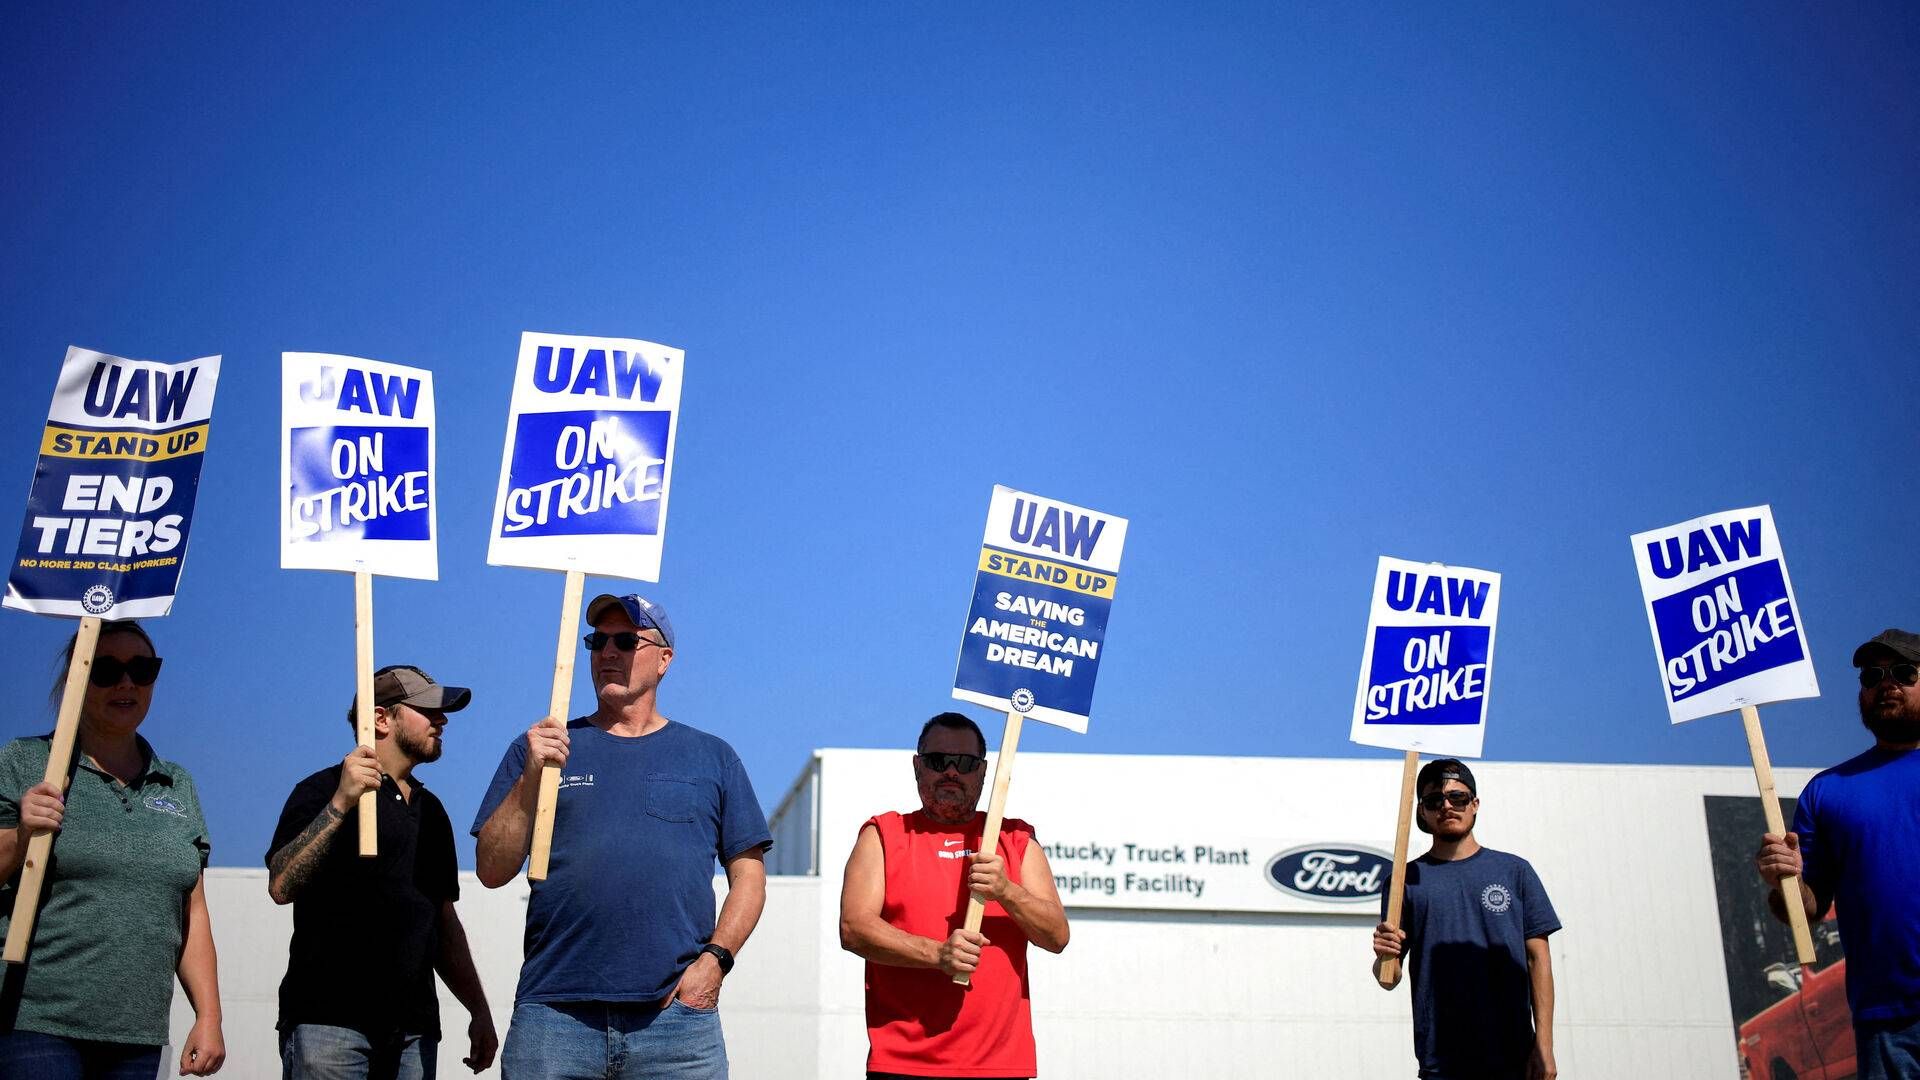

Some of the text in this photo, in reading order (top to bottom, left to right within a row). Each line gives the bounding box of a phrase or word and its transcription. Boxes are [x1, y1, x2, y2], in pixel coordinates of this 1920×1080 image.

[83, 362, 199, 423] UAW
[533, 346, 670, 403] UAW
[52, 431, 200, 458] STAND UP
[330, 432, 383, 479] ON
[555, 416, 619, 470] ON
[62, 474, 174, 513] END
[290, 471, 428, 538] STRIKE
[504, 458, 664, 532] STRIKE
[32, 514, 184, 557] TIERS
[1010, 498, 1106, 561] UAW
[1647, 518, 1761, 580] UAW
[19, 557, 177, 573] NO MORE 2ND CLASS WORKERS
[987, 554, 1107, 592] STAND UP
[994, 591, 1085, 627] SAVING
[1386, 570, 1490, 620] UAW
[1692, 576, 1743, 633] ON
[969, 616, 1098, 659] AMERICAN
[1030, 618, 1047, 628] THE
[986, 643, 1073, 677] DREAM
[1403, 630, 1451, 673] ON
[1667, 597, 1796, 697] STRIKE
[1366, 663, 1486, 720] STRIKE
[1041, 842, 1249, 865] ntucky Truck Plant
[1294, 851, 1382, 892] Ford
[1053, 872, 1205, 897] mping Facility
